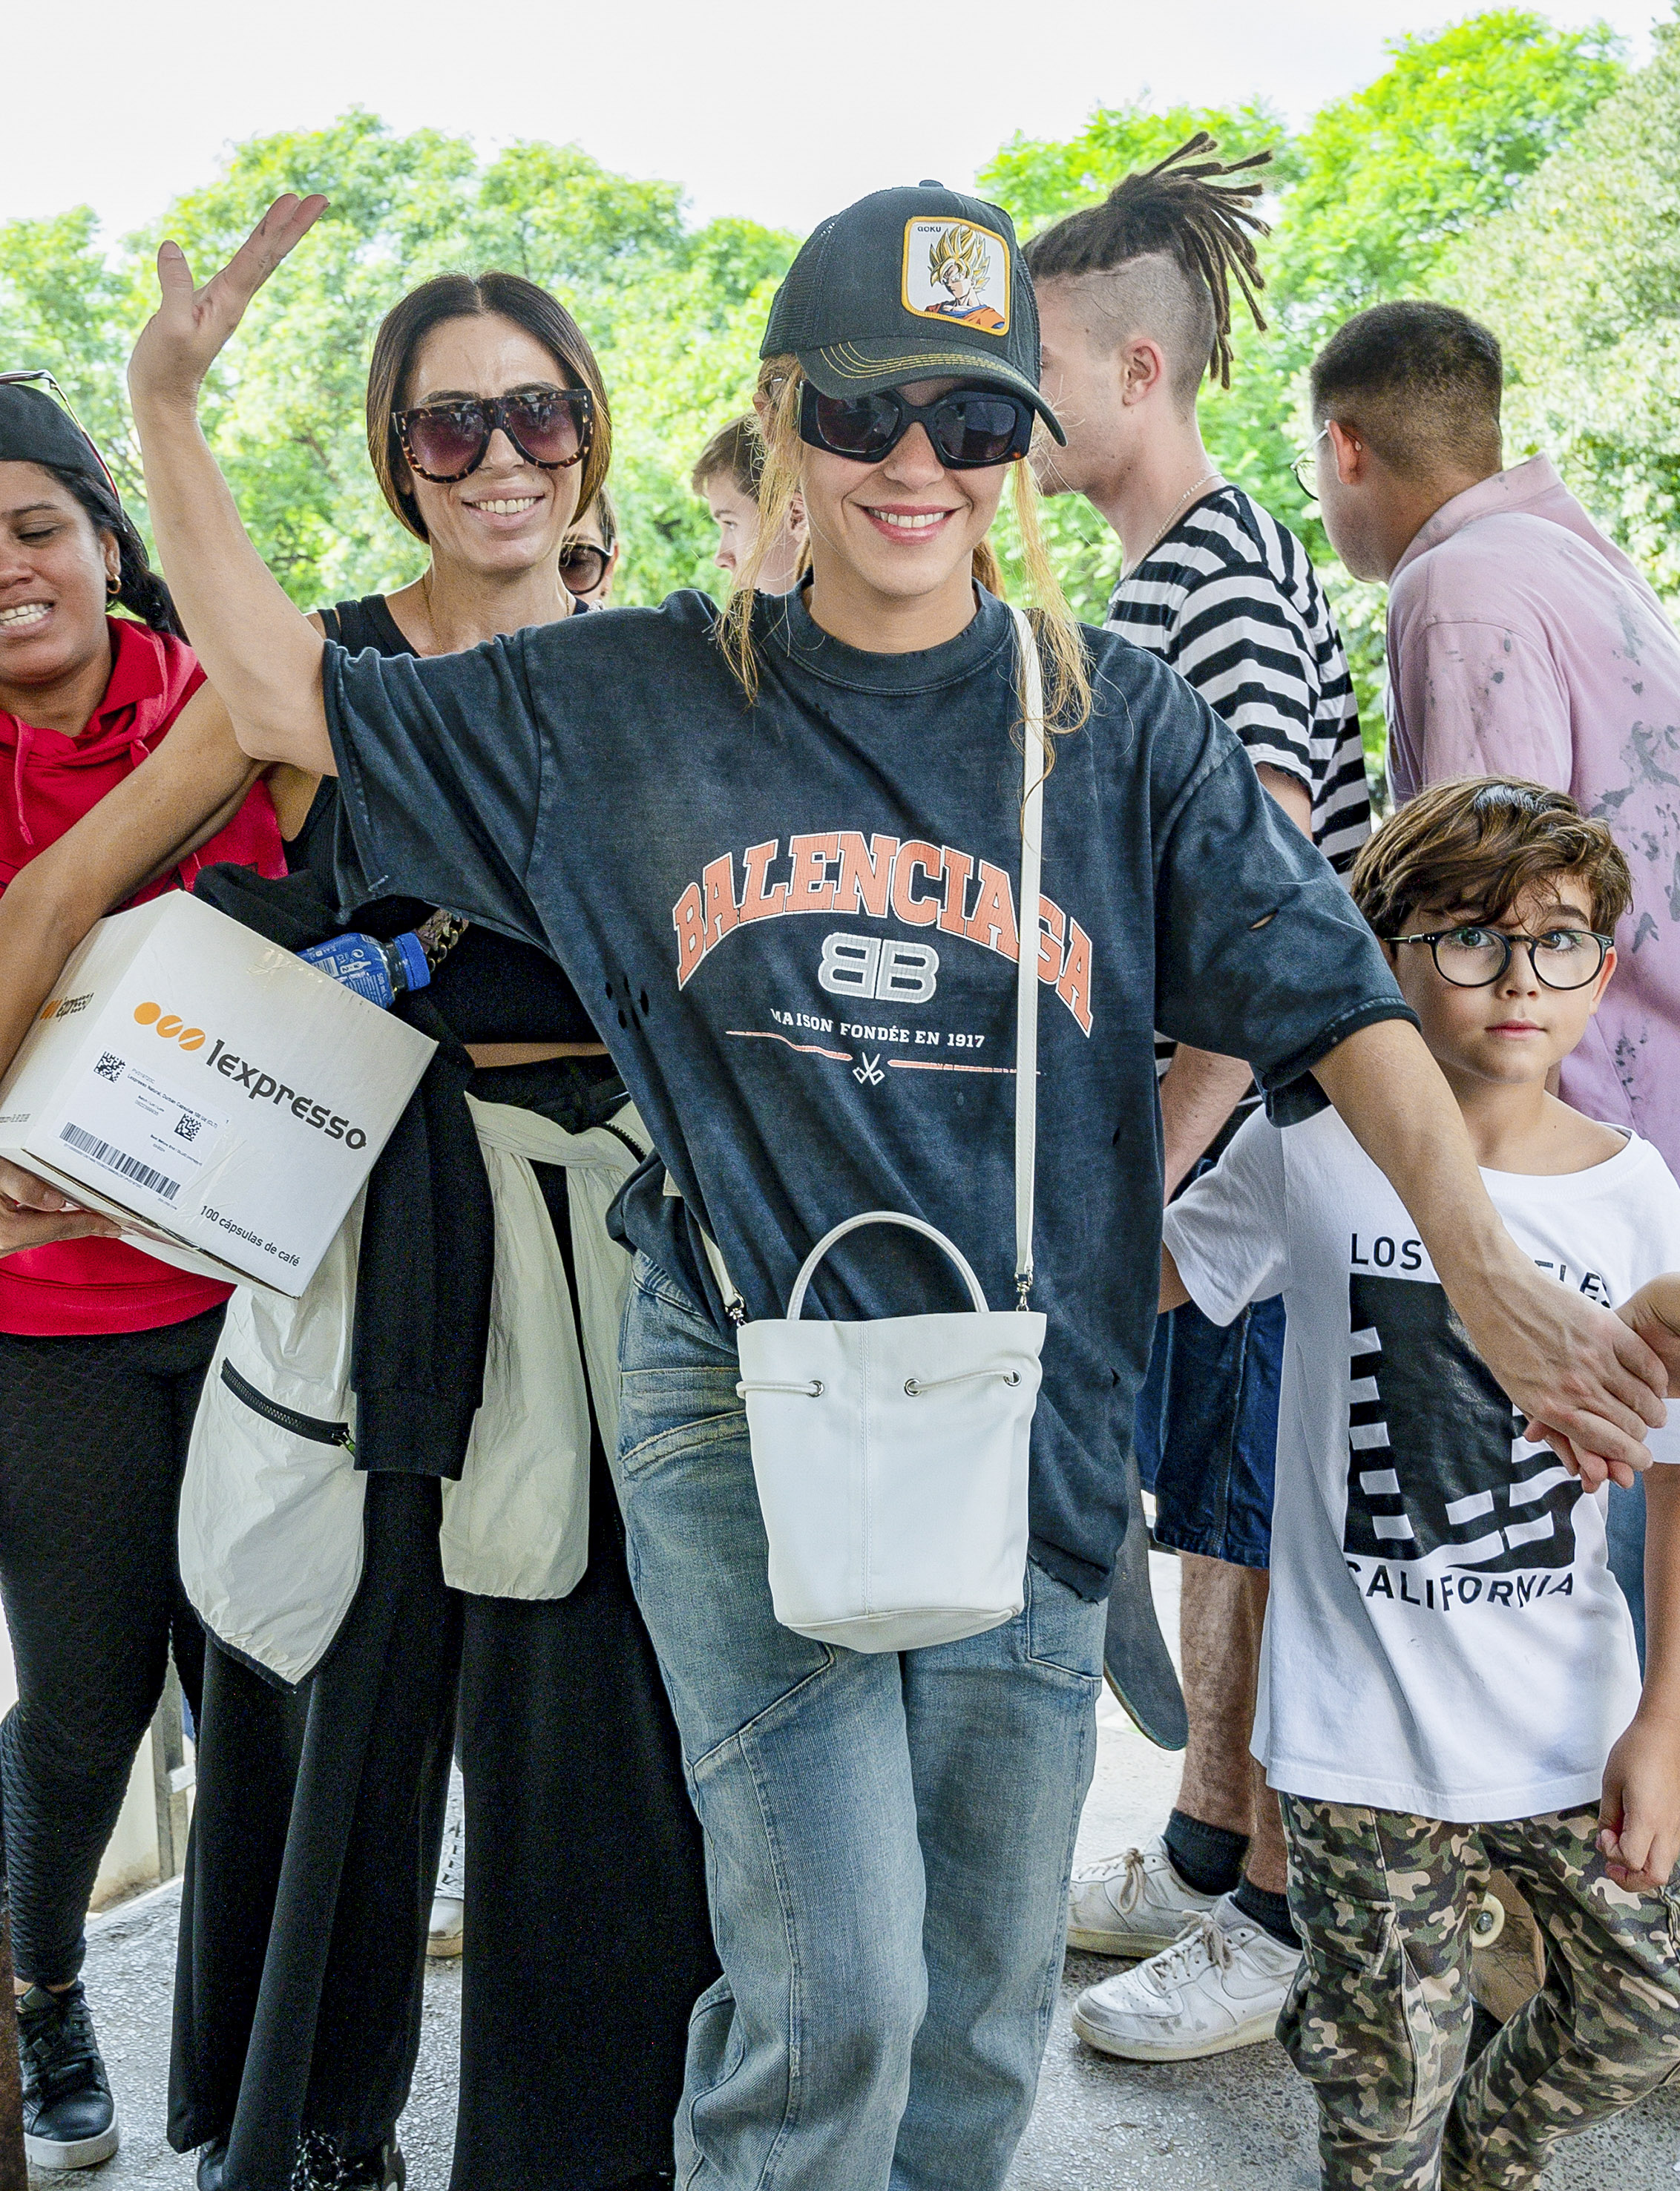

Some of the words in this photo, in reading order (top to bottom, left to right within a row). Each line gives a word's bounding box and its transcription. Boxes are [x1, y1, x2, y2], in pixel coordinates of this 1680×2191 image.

[672, 831, 1093, 1038] BALENCIAGA
[840, 1025, 910, 1043] FONDÉE
[915, 1030, 939, 1045] EN
[947, 1033, 985, 1048] 1917
[206, 1039, 367, 1151] lexpresso
[200, 1205, 220, 1222] 100
[219, 1219, 263, 1246] cápsulas
[264, 1242, 278, 1255] de
[278, 1251, 301, 1267] café
[1351, 1233, 1423, 1269] LOS
